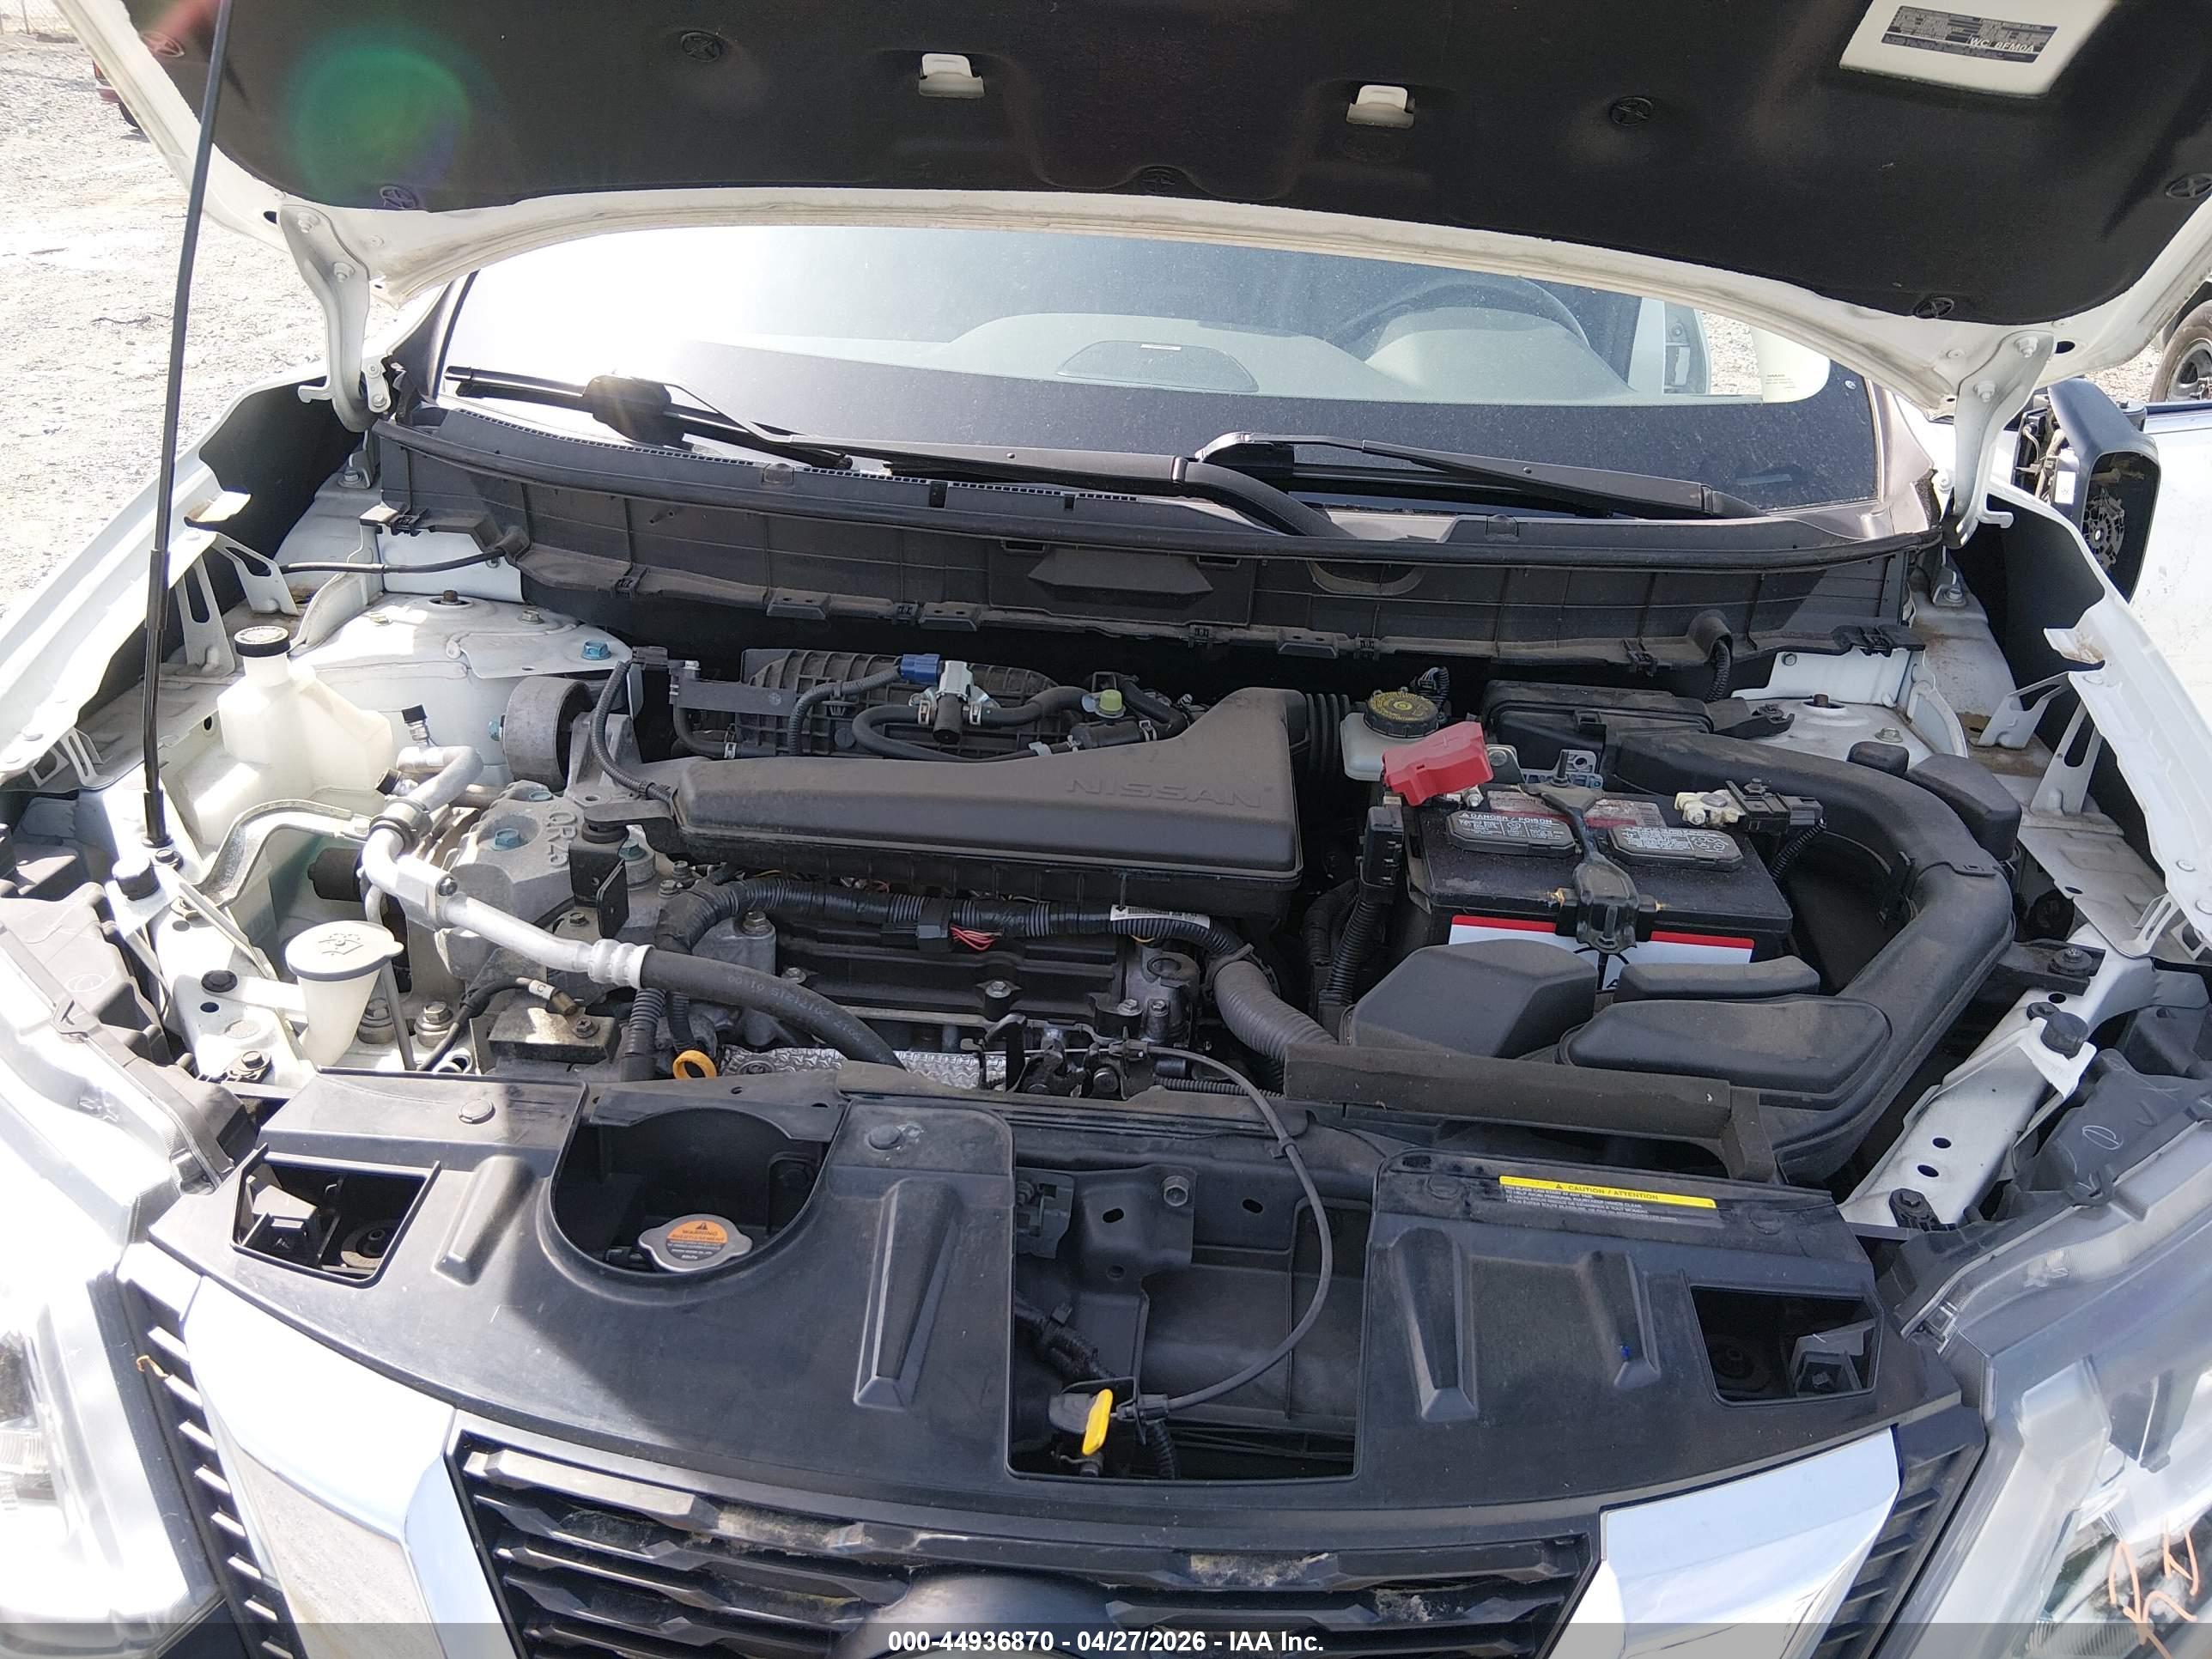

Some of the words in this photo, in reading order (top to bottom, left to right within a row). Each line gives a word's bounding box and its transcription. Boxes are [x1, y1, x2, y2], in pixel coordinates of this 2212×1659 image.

[1066, 779, 1261, 809] NISSAN
[1568, 1184, 1605, 1194] CAUTION
[1613, 1190, 1659, 1200] ATTENTION
